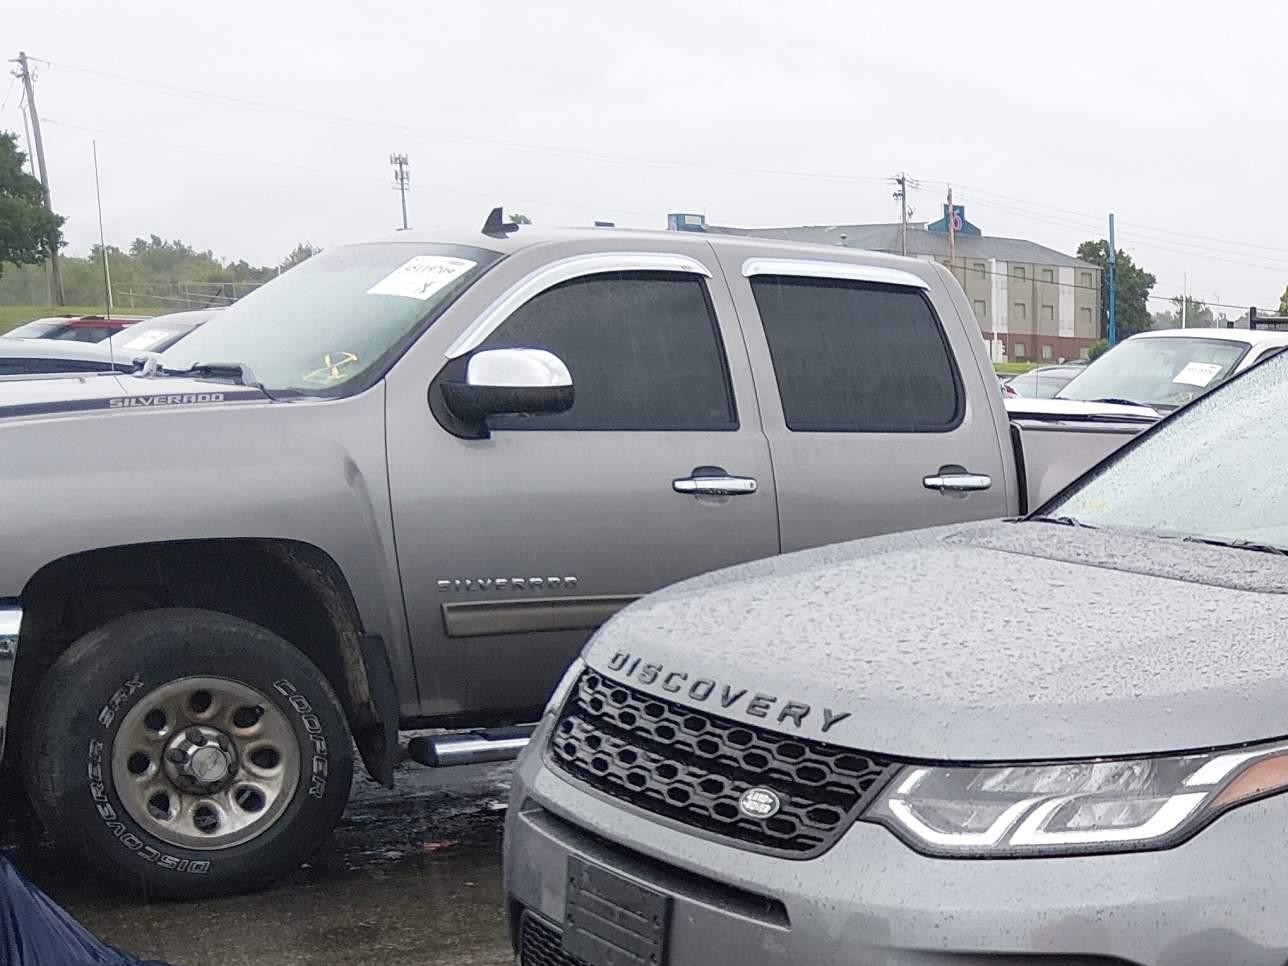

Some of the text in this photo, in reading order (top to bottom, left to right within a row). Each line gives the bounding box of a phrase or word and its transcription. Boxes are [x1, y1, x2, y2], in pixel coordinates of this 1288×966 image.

[109, 393, 224, 408] SILVERADO
[437, 576, 578, 592] SILVERADO
[607, 652, 853, 733] DISCOVERY
[273, 678, 328, 799] COOPER
[88, 738, 210, 874] DISCOVERER
